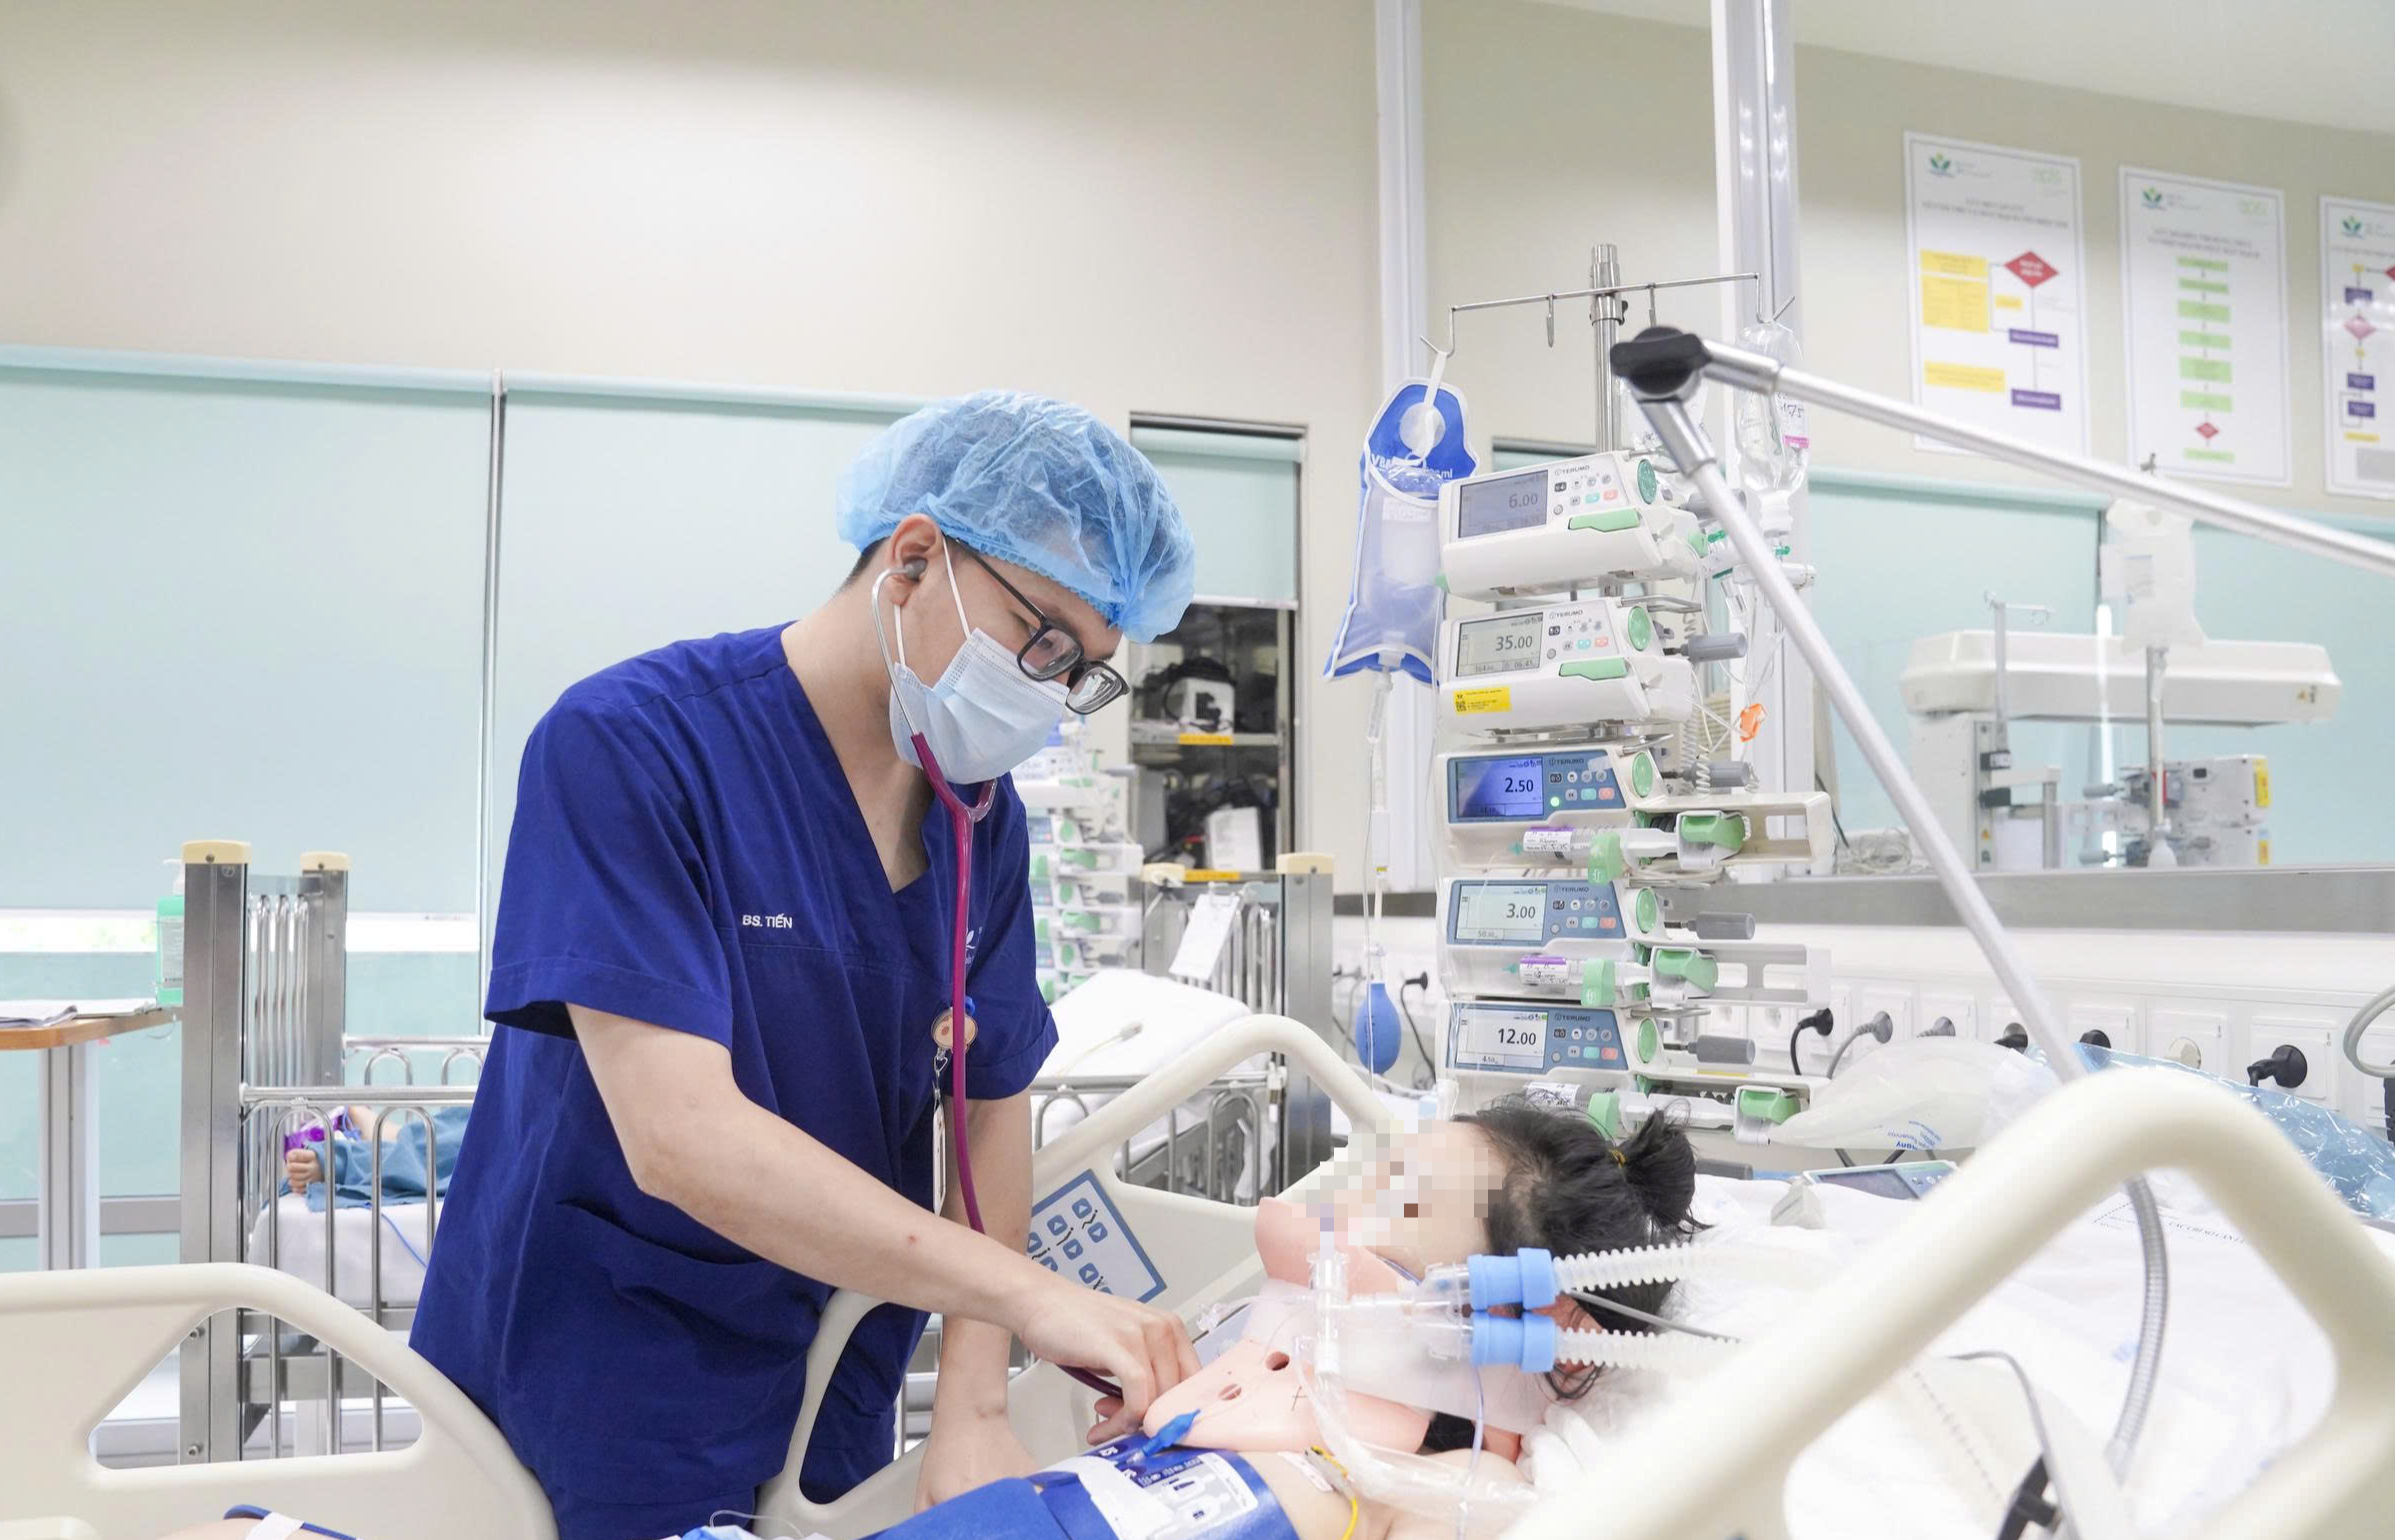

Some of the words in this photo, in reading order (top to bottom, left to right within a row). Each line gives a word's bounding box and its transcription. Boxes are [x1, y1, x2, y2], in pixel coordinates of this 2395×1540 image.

[1508, 492, 1538, 509] 6.00
[1495, 634, 1533, 651] 35.00
[1504, 777, 1534, 793] 2.50
[1506, 903, 1536, 919] 3.00
[742, 914, 763, 927] BS.
[765, 913, 793, 929] TIẾN
[1498, 1028, 1537, 1045] 12.00
